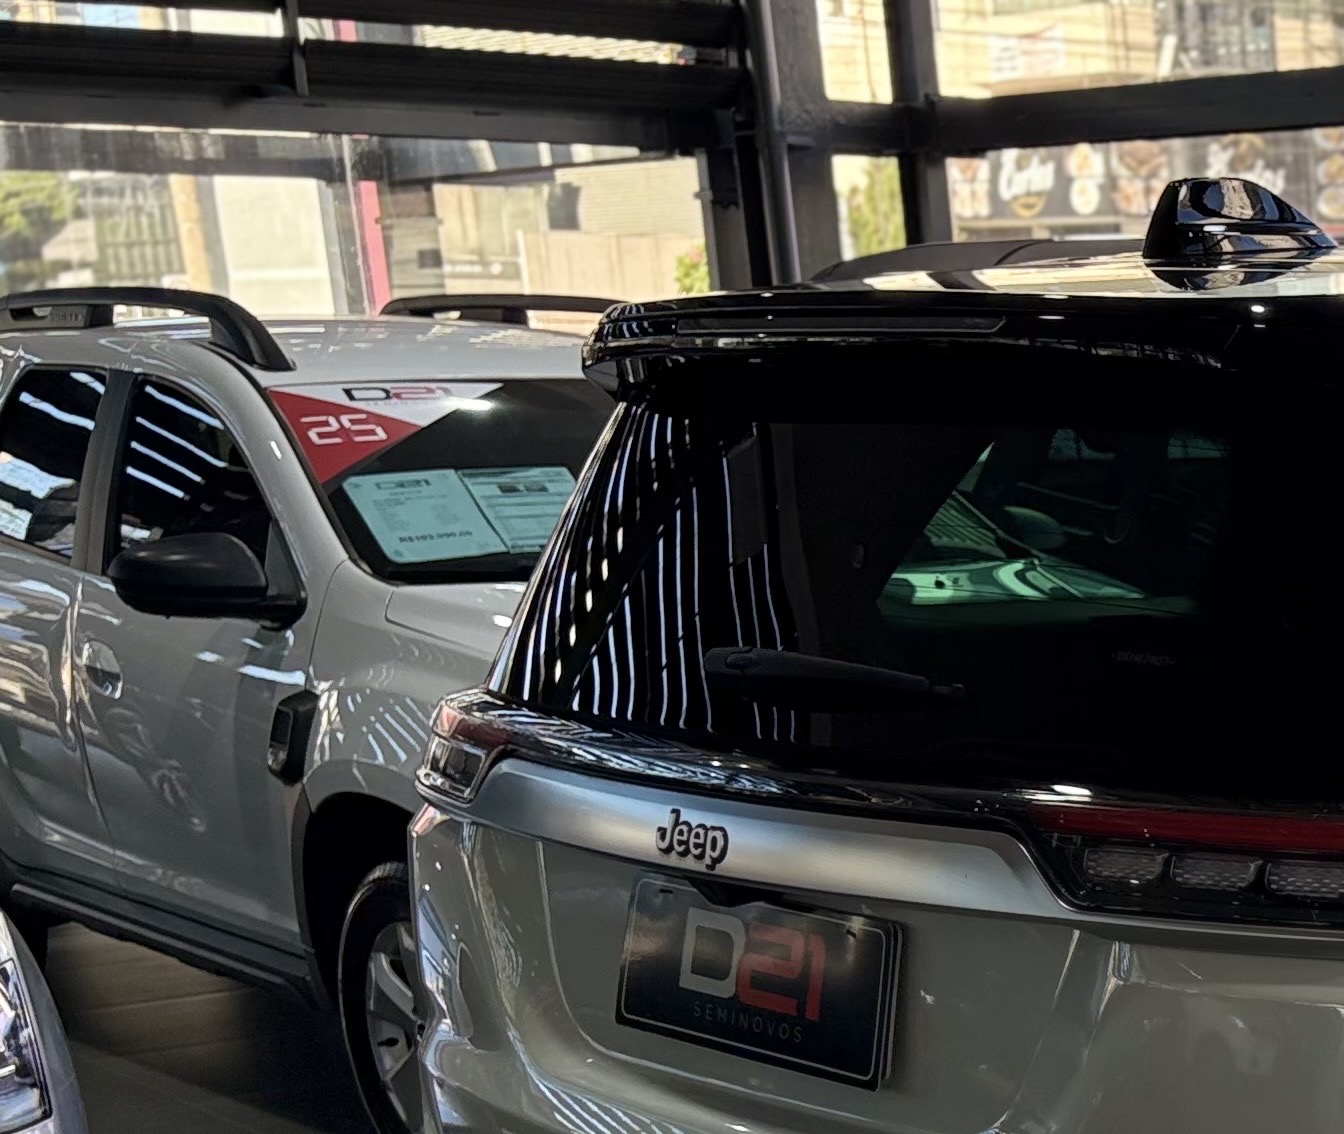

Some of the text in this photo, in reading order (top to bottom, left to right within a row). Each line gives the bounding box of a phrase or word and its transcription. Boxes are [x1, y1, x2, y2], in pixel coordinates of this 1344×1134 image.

[299, 413, 389, 446] 25
[656, 808, 729, 871] Jeep
[679, 906, 826, 1022] D21
[693, 1000, 802, 1044] SEMINOVOS
